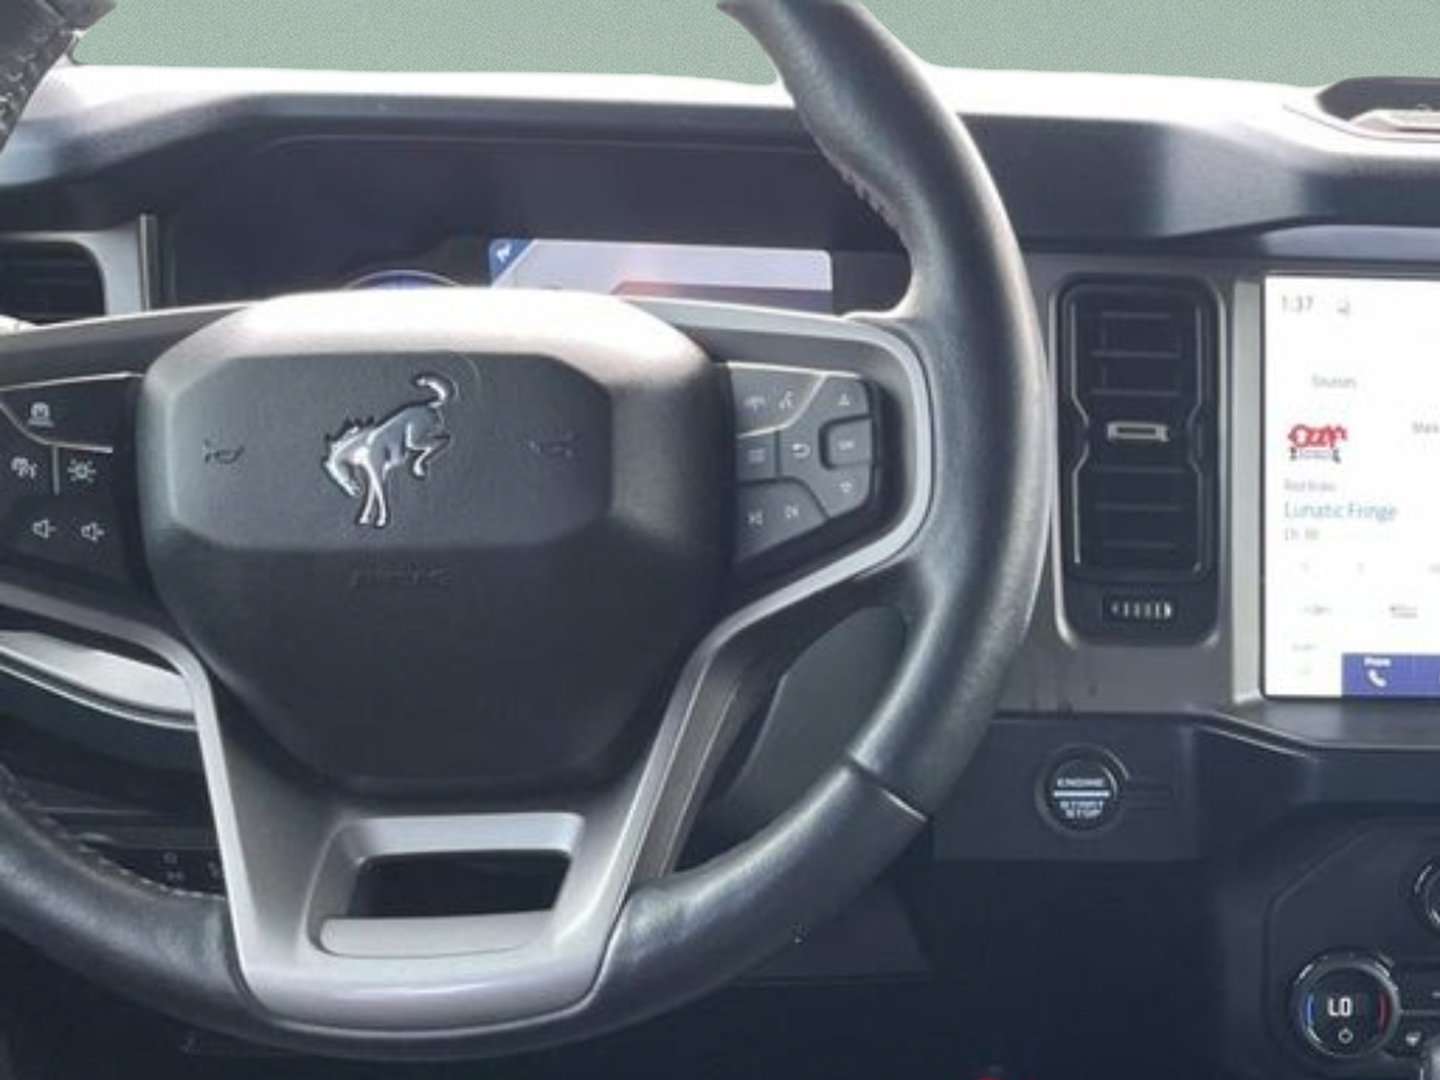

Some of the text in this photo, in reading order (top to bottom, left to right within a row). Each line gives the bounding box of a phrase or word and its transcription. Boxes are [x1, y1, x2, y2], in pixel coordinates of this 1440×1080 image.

[1282, 295, 1314, 313] 1:37
[1284, 501, 1399, 523] Lunatic Fringe
[1057, 778, 1105, 788] ENGINE
[1065, 809, 1101, 819] STOP
[1328, 997, 1351, 1017] LO
